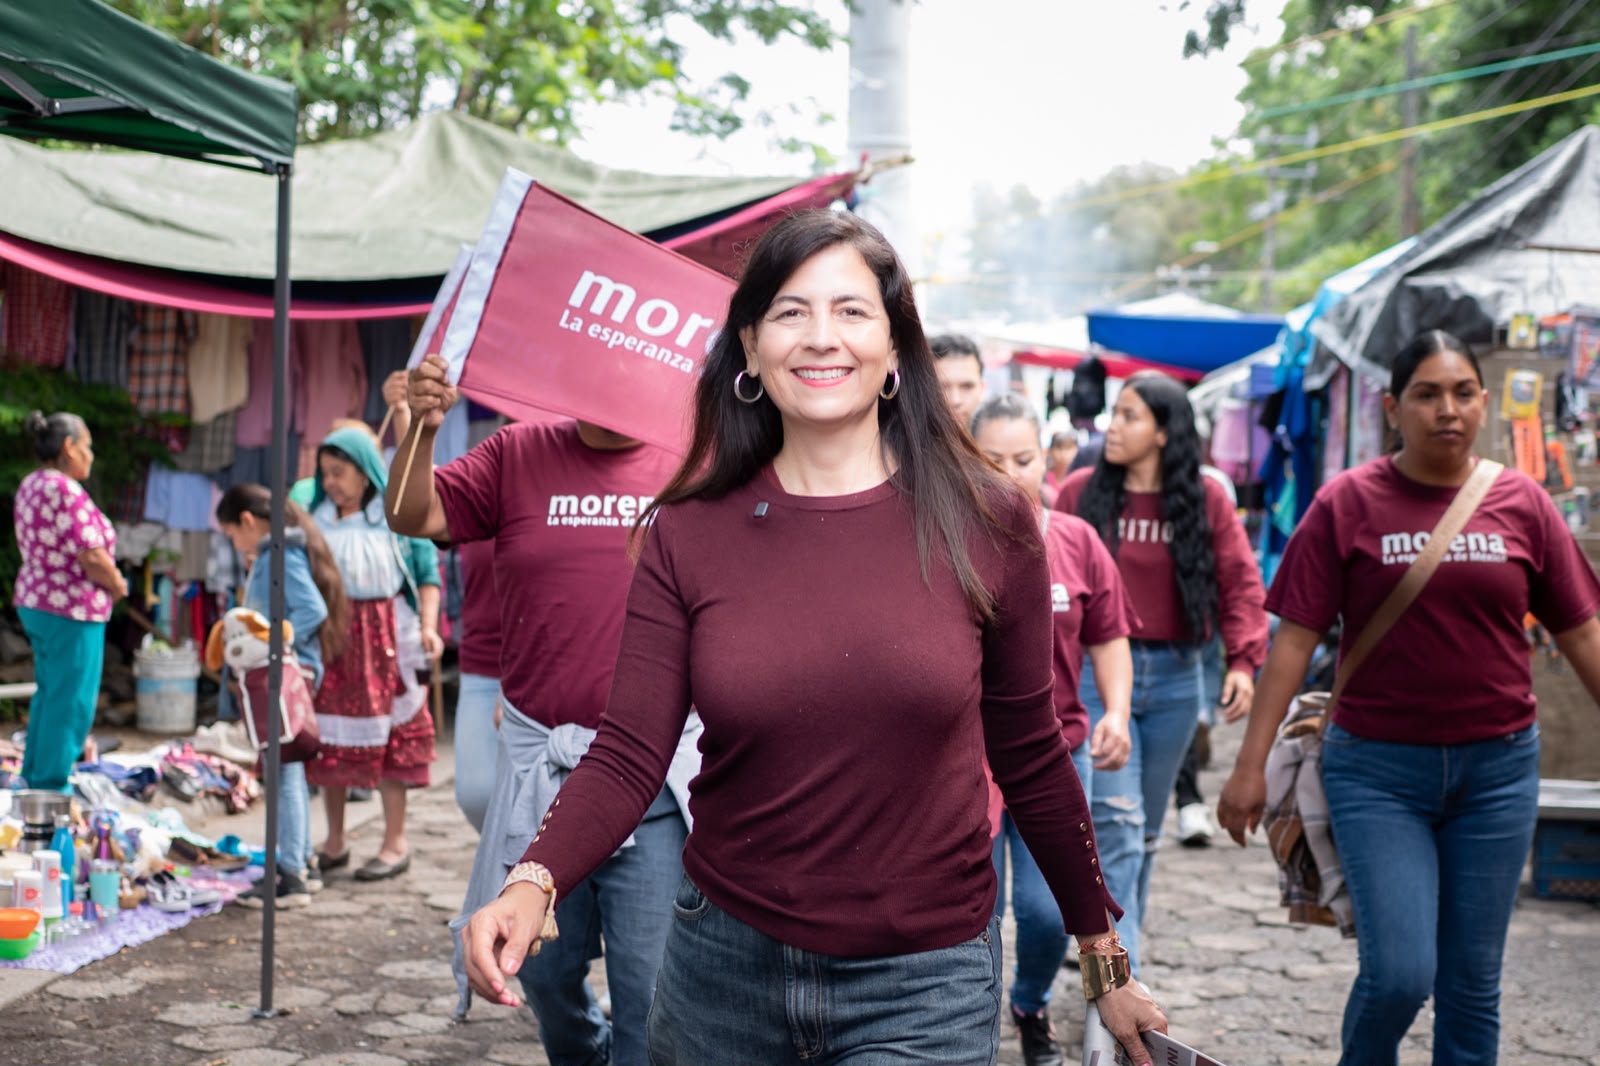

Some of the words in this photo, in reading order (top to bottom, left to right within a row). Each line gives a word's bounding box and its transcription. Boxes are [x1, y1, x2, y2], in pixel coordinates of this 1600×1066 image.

[559, 308, 584, 333] La
[587, 322, 695, 374] esperanza
[547, 515, 559, 526] La
[561, 516, 618, 527] esperanza
[1381, 531, 1507, 555] moena
